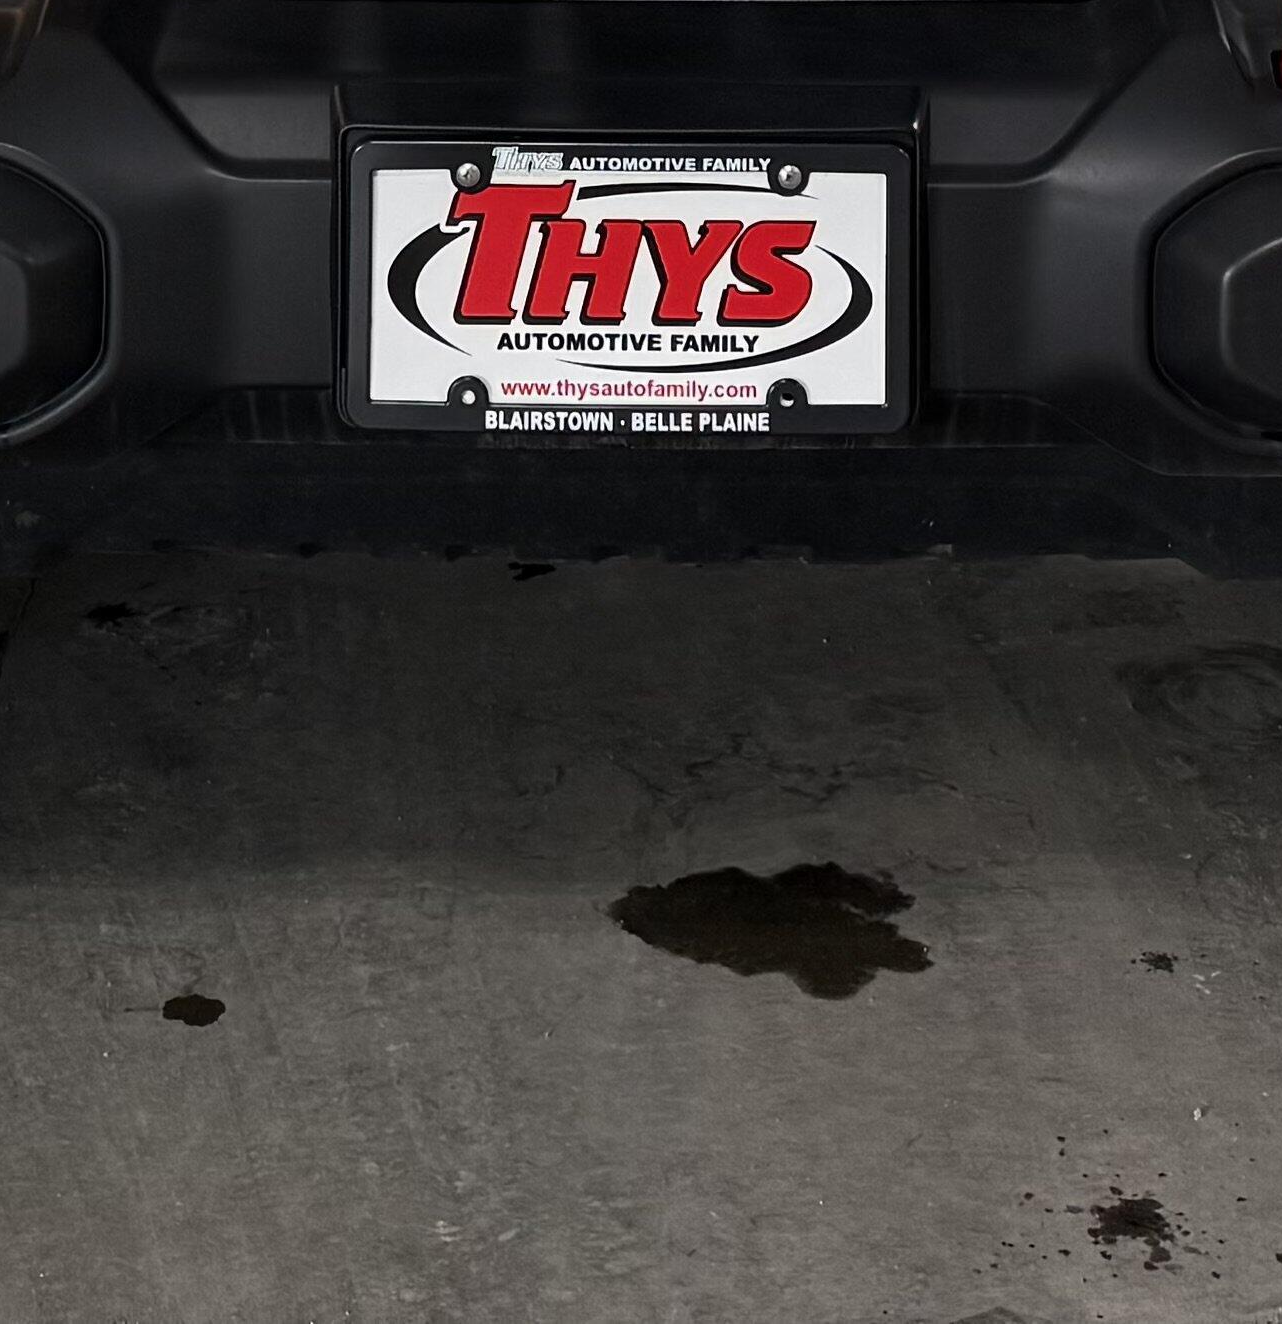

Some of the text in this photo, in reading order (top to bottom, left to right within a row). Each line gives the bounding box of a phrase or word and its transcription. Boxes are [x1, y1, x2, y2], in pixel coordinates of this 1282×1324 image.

[569, 156, 697, 171] AUTOMOTIVE
[702, 156, 772, 171] FAMILY
[446, 179, 817, 327] THYS
[496, 332, 760, 353] AUTOMOTIVE FAMILY
[500, 379, 758, 402] www.thysautofamily.com
[484, 410, 770, 432] BLAIRSTOWN BELLE PLAINE
